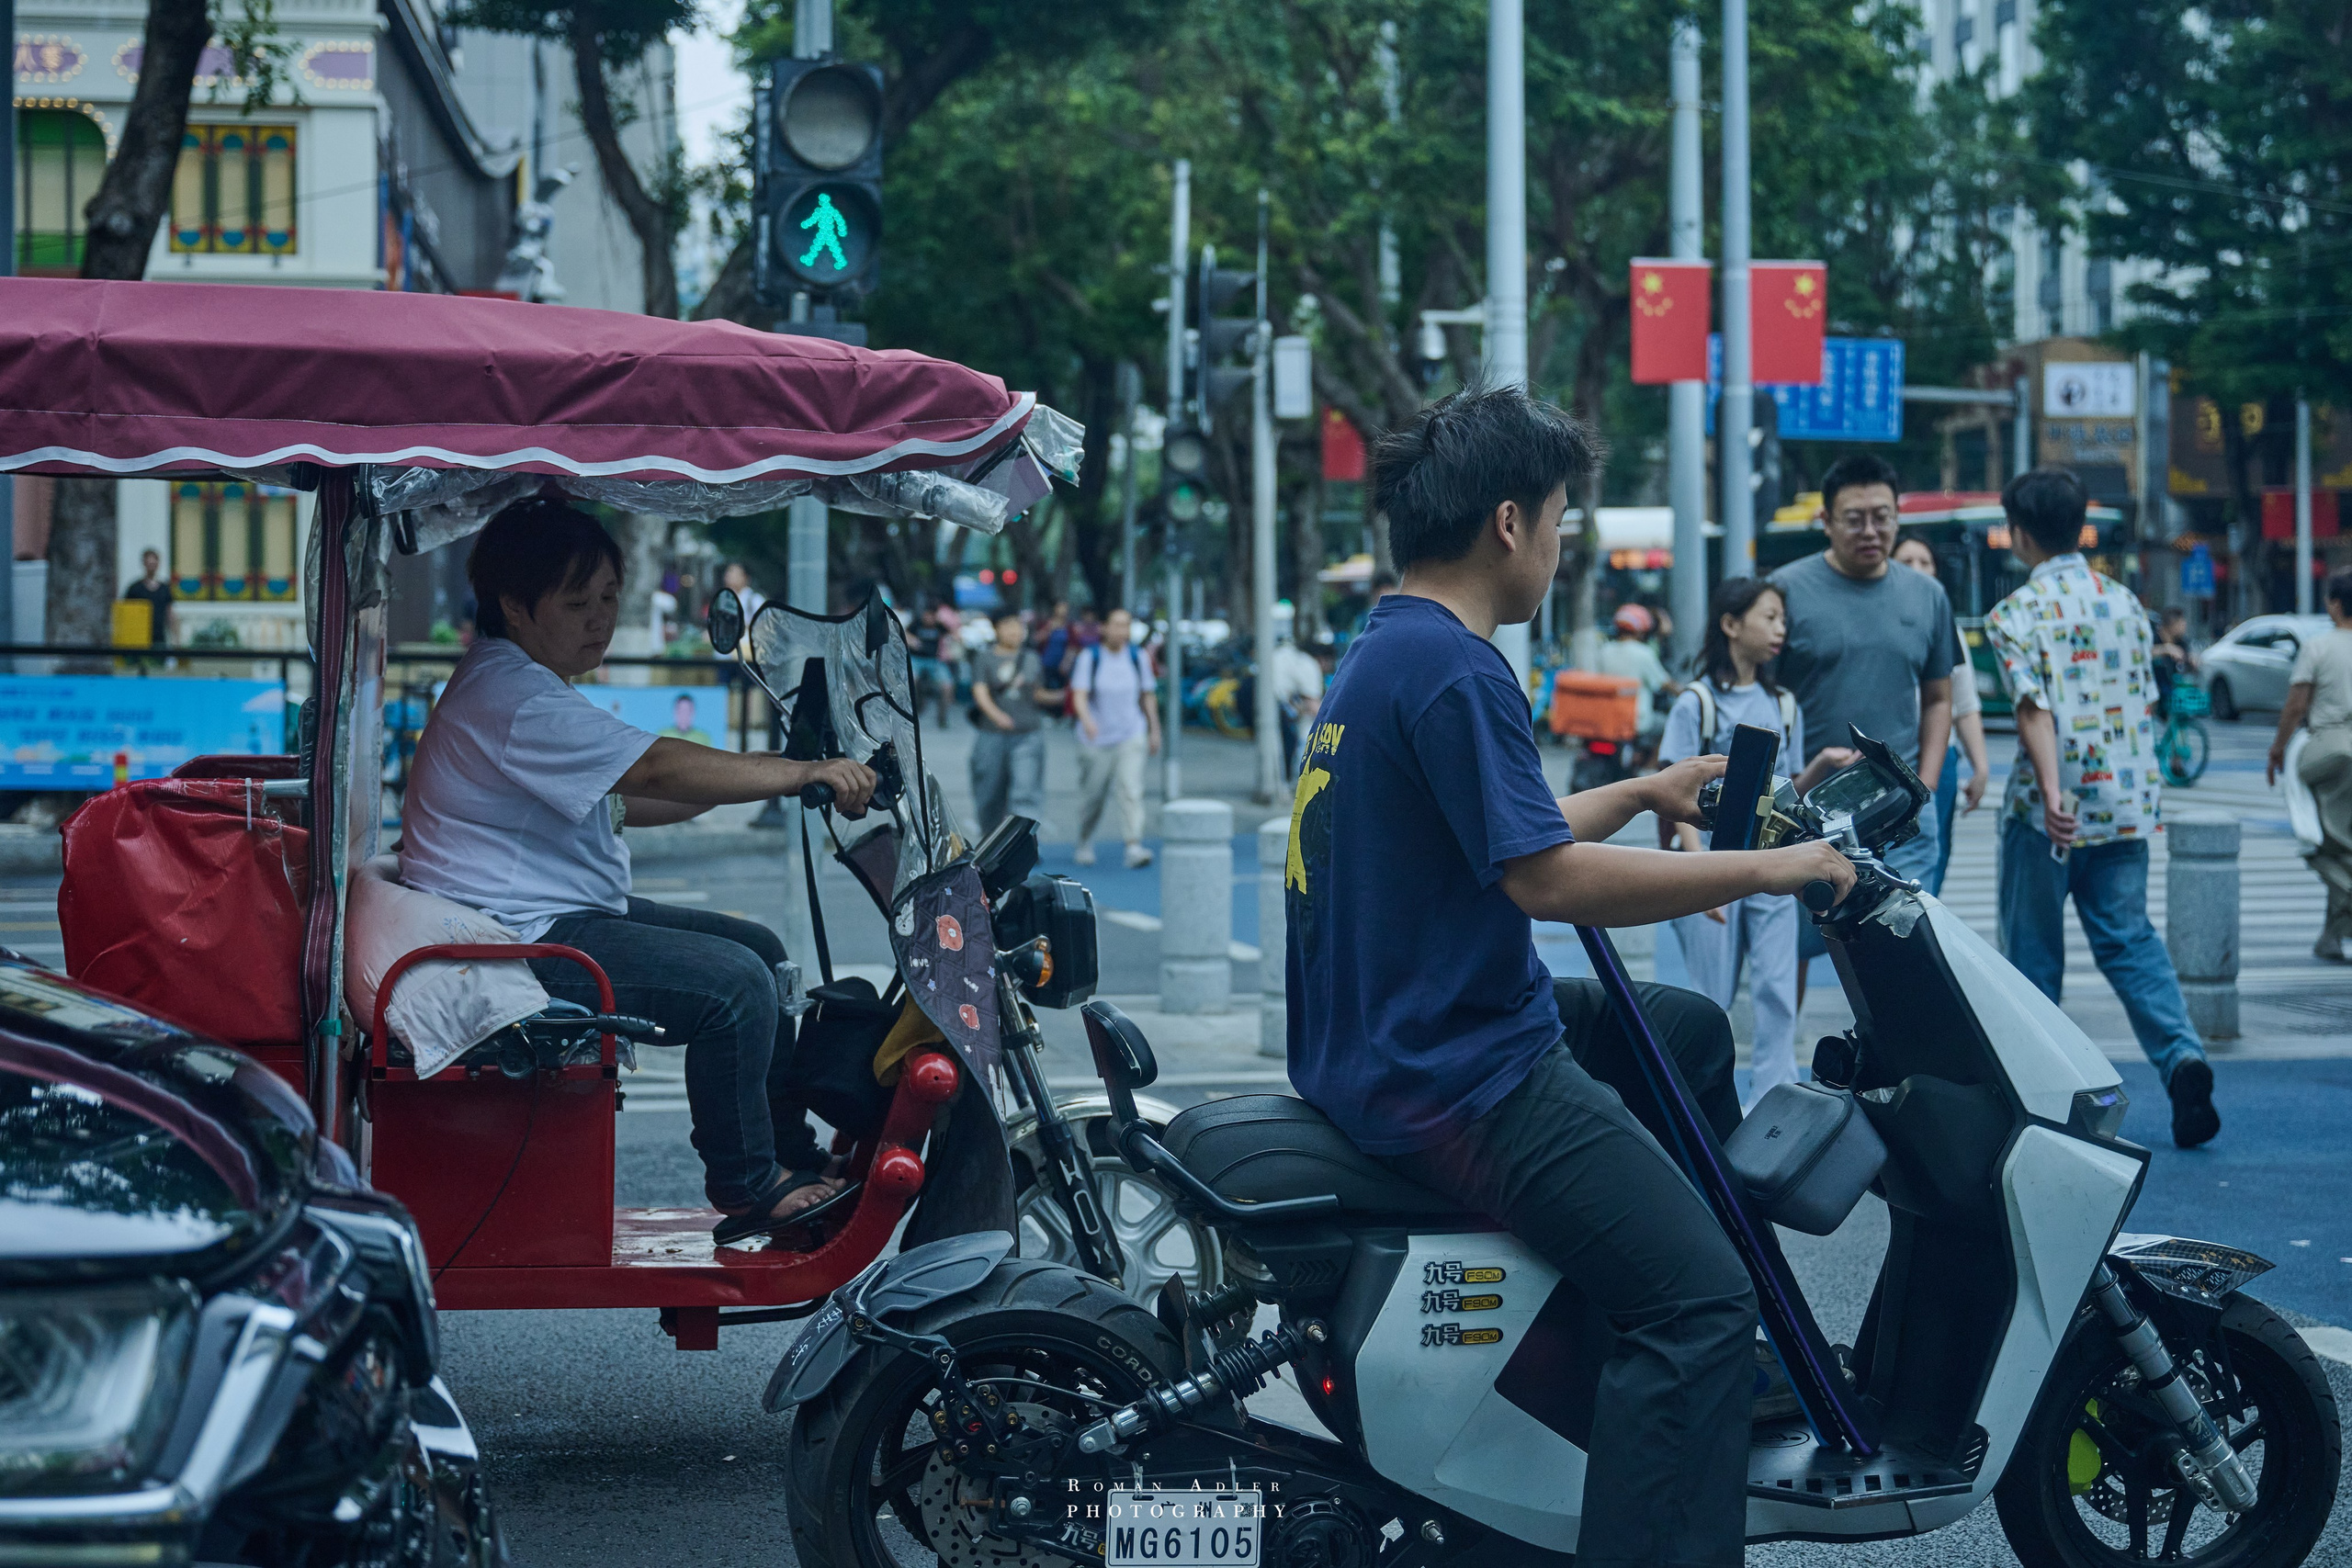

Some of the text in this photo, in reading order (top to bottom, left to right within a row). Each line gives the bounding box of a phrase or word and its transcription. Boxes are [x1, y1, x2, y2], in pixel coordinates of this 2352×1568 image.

[909, 955, 930, 967] love
[1424, 1261, 1463, 1284] 九号
[1420, 1290, 1461, 1313] 九号
[1420, 1324, 1461, 1347] 九号
[1060, 1521, 1099, 1551] 九号
[1114, 1526, 1253, 1560] MG6105
